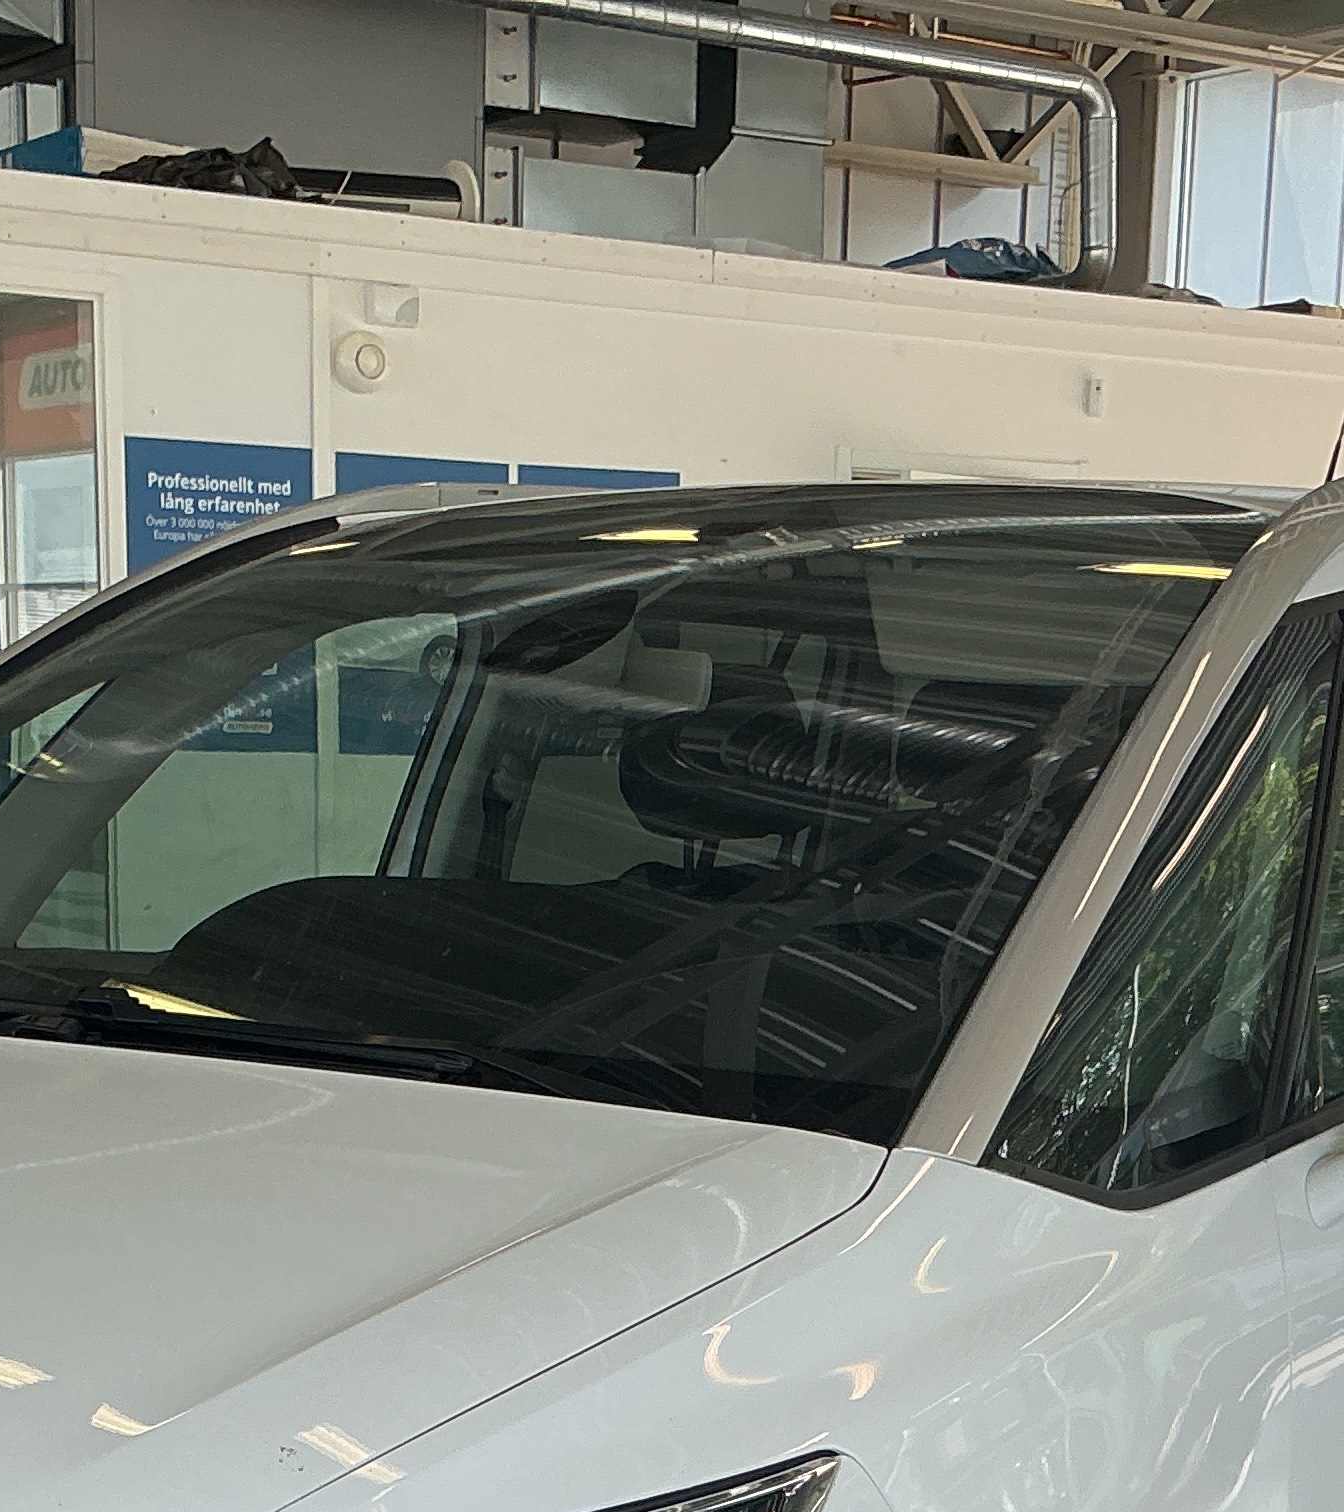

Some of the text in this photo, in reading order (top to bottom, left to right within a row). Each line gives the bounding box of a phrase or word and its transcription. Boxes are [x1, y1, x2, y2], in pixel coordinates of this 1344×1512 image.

[147, 471, 292, 497] Professionellt med
[160, 492, 281, 515] lång erfarenhet
